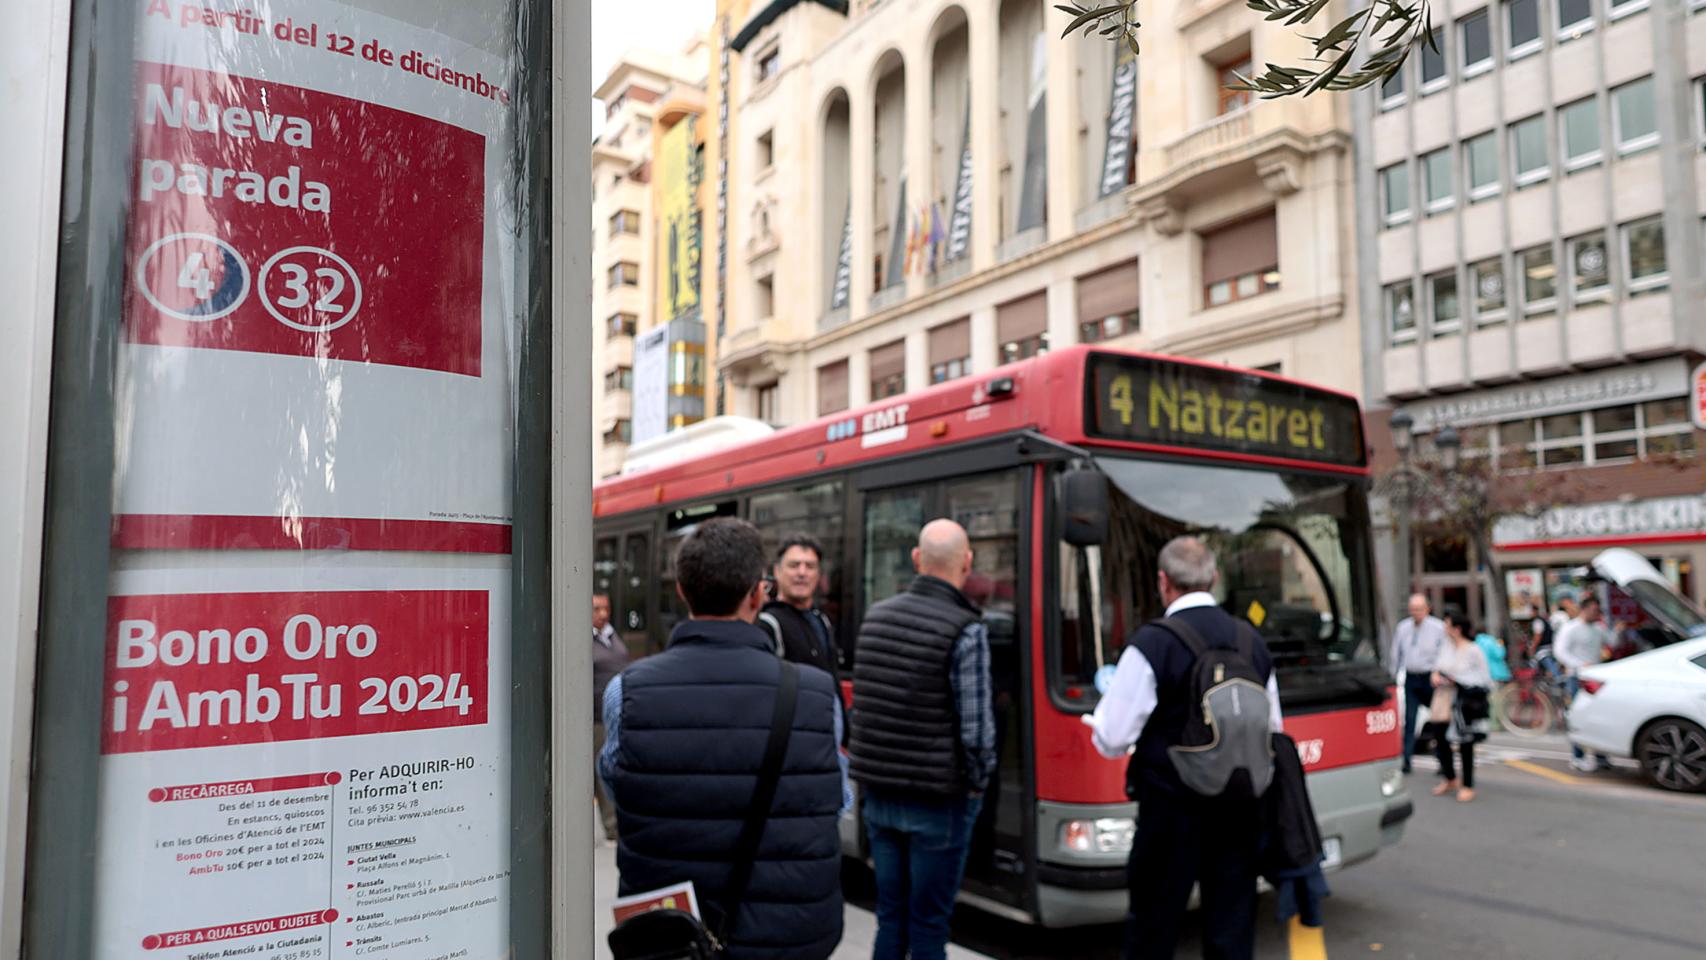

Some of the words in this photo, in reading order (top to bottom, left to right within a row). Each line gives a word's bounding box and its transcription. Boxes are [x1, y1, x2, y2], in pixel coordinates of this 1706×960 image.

[147, 0, 172, 20] A
[180, 3, 264, 36] partir
[274, 18, 317, 48] del
[326, 32, 355, 57] 12
[361, 40, 394, 67] de
[400, 49, 510, 105] diciembre
[144, 82, 314, 149] Nueva
[141, 157, 332, 214] parada
[176, 251, 215, 300] 4
[277, 262, 345, 313] 32
[861, 403, 909, 433] EMT
[1109, 374, 1134, 426] 4
[1148, 377, 1327, 451] Natzaret
[116, 618, 268, 669] Bono
[283, 614, 378, 660] Oro
[112, 680, 129, 732] i
[138, 672, 341, 731] AmbTu
[358, 672, 474, 717] 2024
[349, 769, 375, 783] Per
[379, 756, 475, 779] ADQUIRIR-HO
[172, 782, 254, 800] RECÀRREGA
[218, 802, 236, 812] Des
[240, 800, 254, 810] del
[257, 800, 266, 808] 11
[268, 798, 280, 806] de
[283, 792, 330, 805] desembre
[349, 780, 417, 801] informa't
[422, 779, 444, 792] en:
[227, 816, 240, 826] En
[243, 814, 282, 824] estancs,
[284, 808, 325, 822] quioscos
[348, 806, 364, 816] Tel.
[366, 803, 378, 815] 96
[379, 802, 394, 814] 352
[397, 801, 408, 811] 54
[410, 799, 419, 808] 78
[348, 817, 364, 828] Cita
[367, 813, 397, 827] prèvia:
[399, 804, 465, 822] www.valencia.es
[162, 840, 175, 848] en
[178, 837, 192, 848] les
[195, 832, 234, 846] Oficines
[237, 827, 282, 840] d'Atenció
[286, 825, 298, 834] de
[300, 820, 325, 834] l'EMT
[347, 842, 373, 854] JUNTES
[375, 836, 416, 848] MUNICIPALS
[176, 852, 202, 862] Bono
[205, 849, 223, 858] Oro
[226, 848, 244, 857] 20€
[248, 844, 264, 856] per
[276, 840, 289, 850] tot
[291, 838, 300, 848] el
[302, 837, 325, 848] 2024
[357, 856, 378, 864] Ciutat
[380, 852, 396, 861] Vella
[188, 864, 224, 876] AmbTu
[226, 862, 244, 872] 10€
[247, 859, 264, 870] per
[275, 855, 288, 865] tot
[291, 854, 300, 862] el
[302, 852, 325, 862] 2024
[400, 858, 408, 866] el
[356, 878, 384, 888] Russafa
[368, 886, 392, 896] Maties
[356, 894, 394, 907] Provisional
[356, 912, 384, 922] Abastos
[166, 932, 192, 946] PER
[194, 931, 204, 942] A
[206, 920, 276, 942] QUALSEVOL
[279, 913, 318, 930] DUBTE
[188, 948, 220, 960] Telèfon
[222, 944, 256, 958] Atenció
[266, 942, 276, 951] la
[276, 933, 323, 950] Ciutadania
[300, 950, 311, 960] 85
[367, 943, 390, 953] Comte
